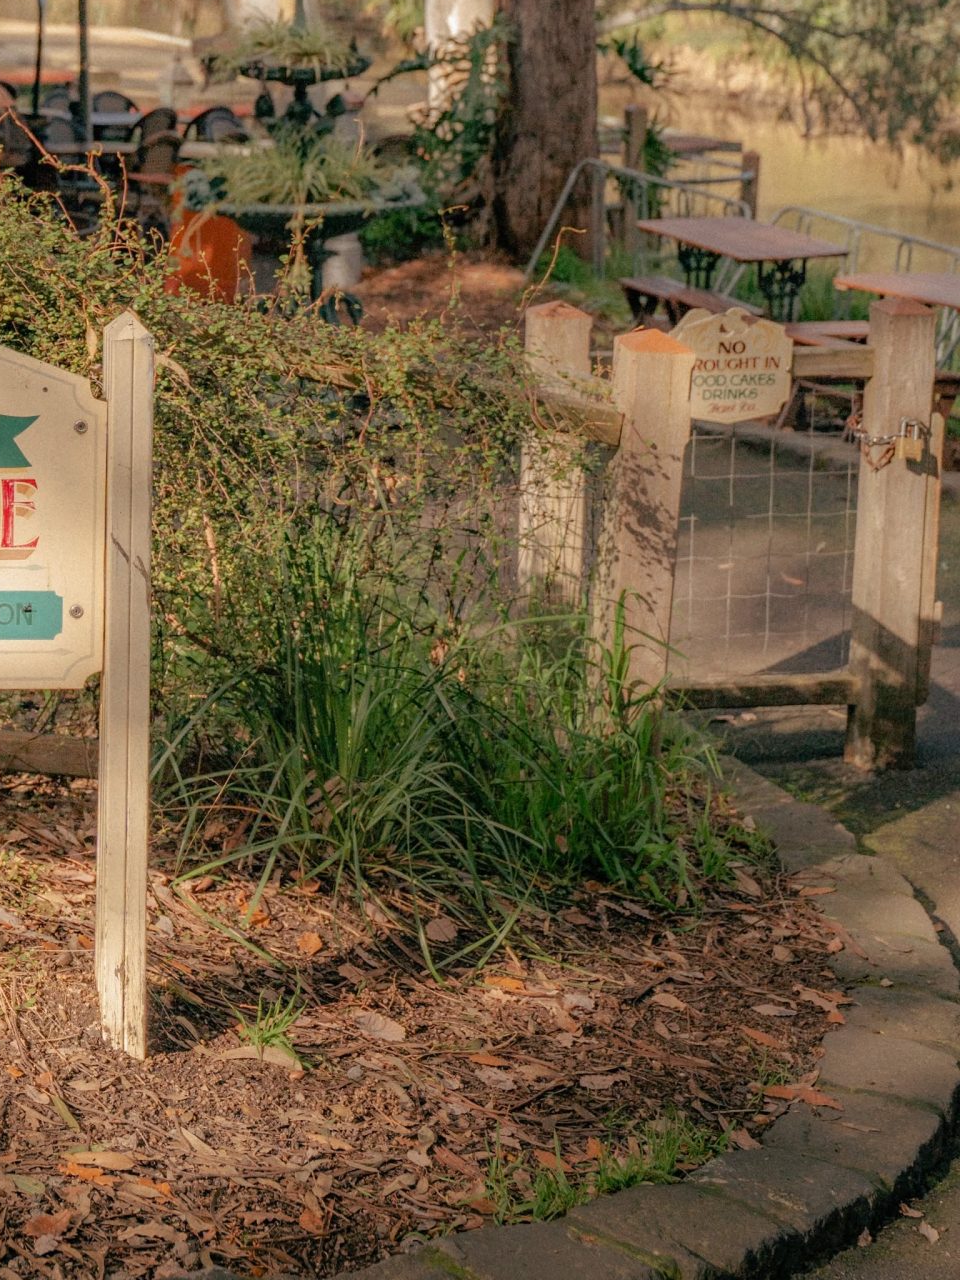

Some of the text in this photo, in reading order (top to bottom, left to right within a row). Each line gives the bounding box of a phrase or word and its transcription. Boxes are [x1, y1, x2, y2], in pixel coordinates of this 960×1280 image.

[718, 340, 746, 354] NO
[693, 355, 781, 372] ROUGHT IN
[693, 372, 776, 387] OOD CAKES
[702, 388, 758, 401] DRINKS
